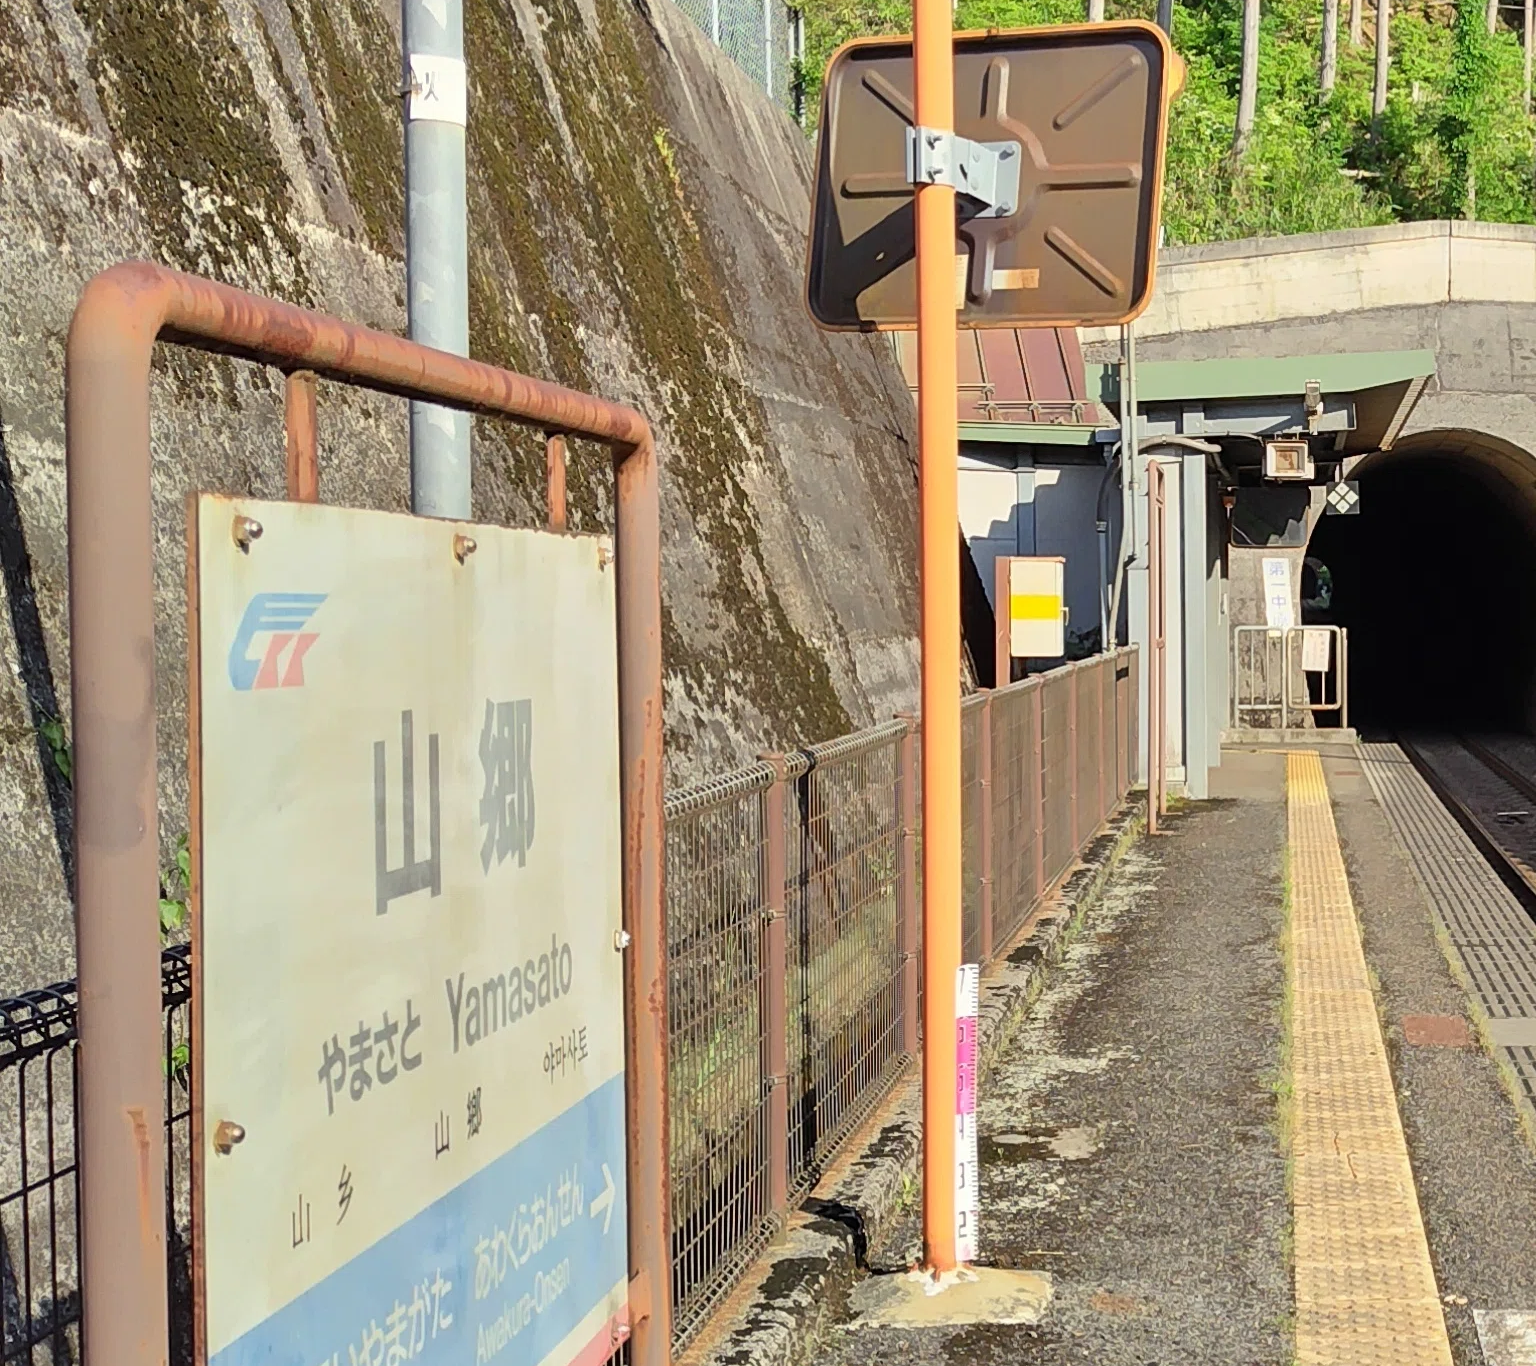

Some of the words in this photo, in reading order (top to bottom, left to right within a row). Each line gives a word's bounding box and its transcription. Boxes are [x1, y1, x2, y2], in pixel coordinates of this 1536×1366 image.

[374, 698, 535, 916] 山郷
[445, 933, 573, 1054] Yamasato
[318, 999, 422, 1116] やまさと
[543, 1027, 589, 1085] 야마사토
[292, 1164, 354, 1249] 山乡
[474, 1163, 585, 1301] あわくらおんせん
